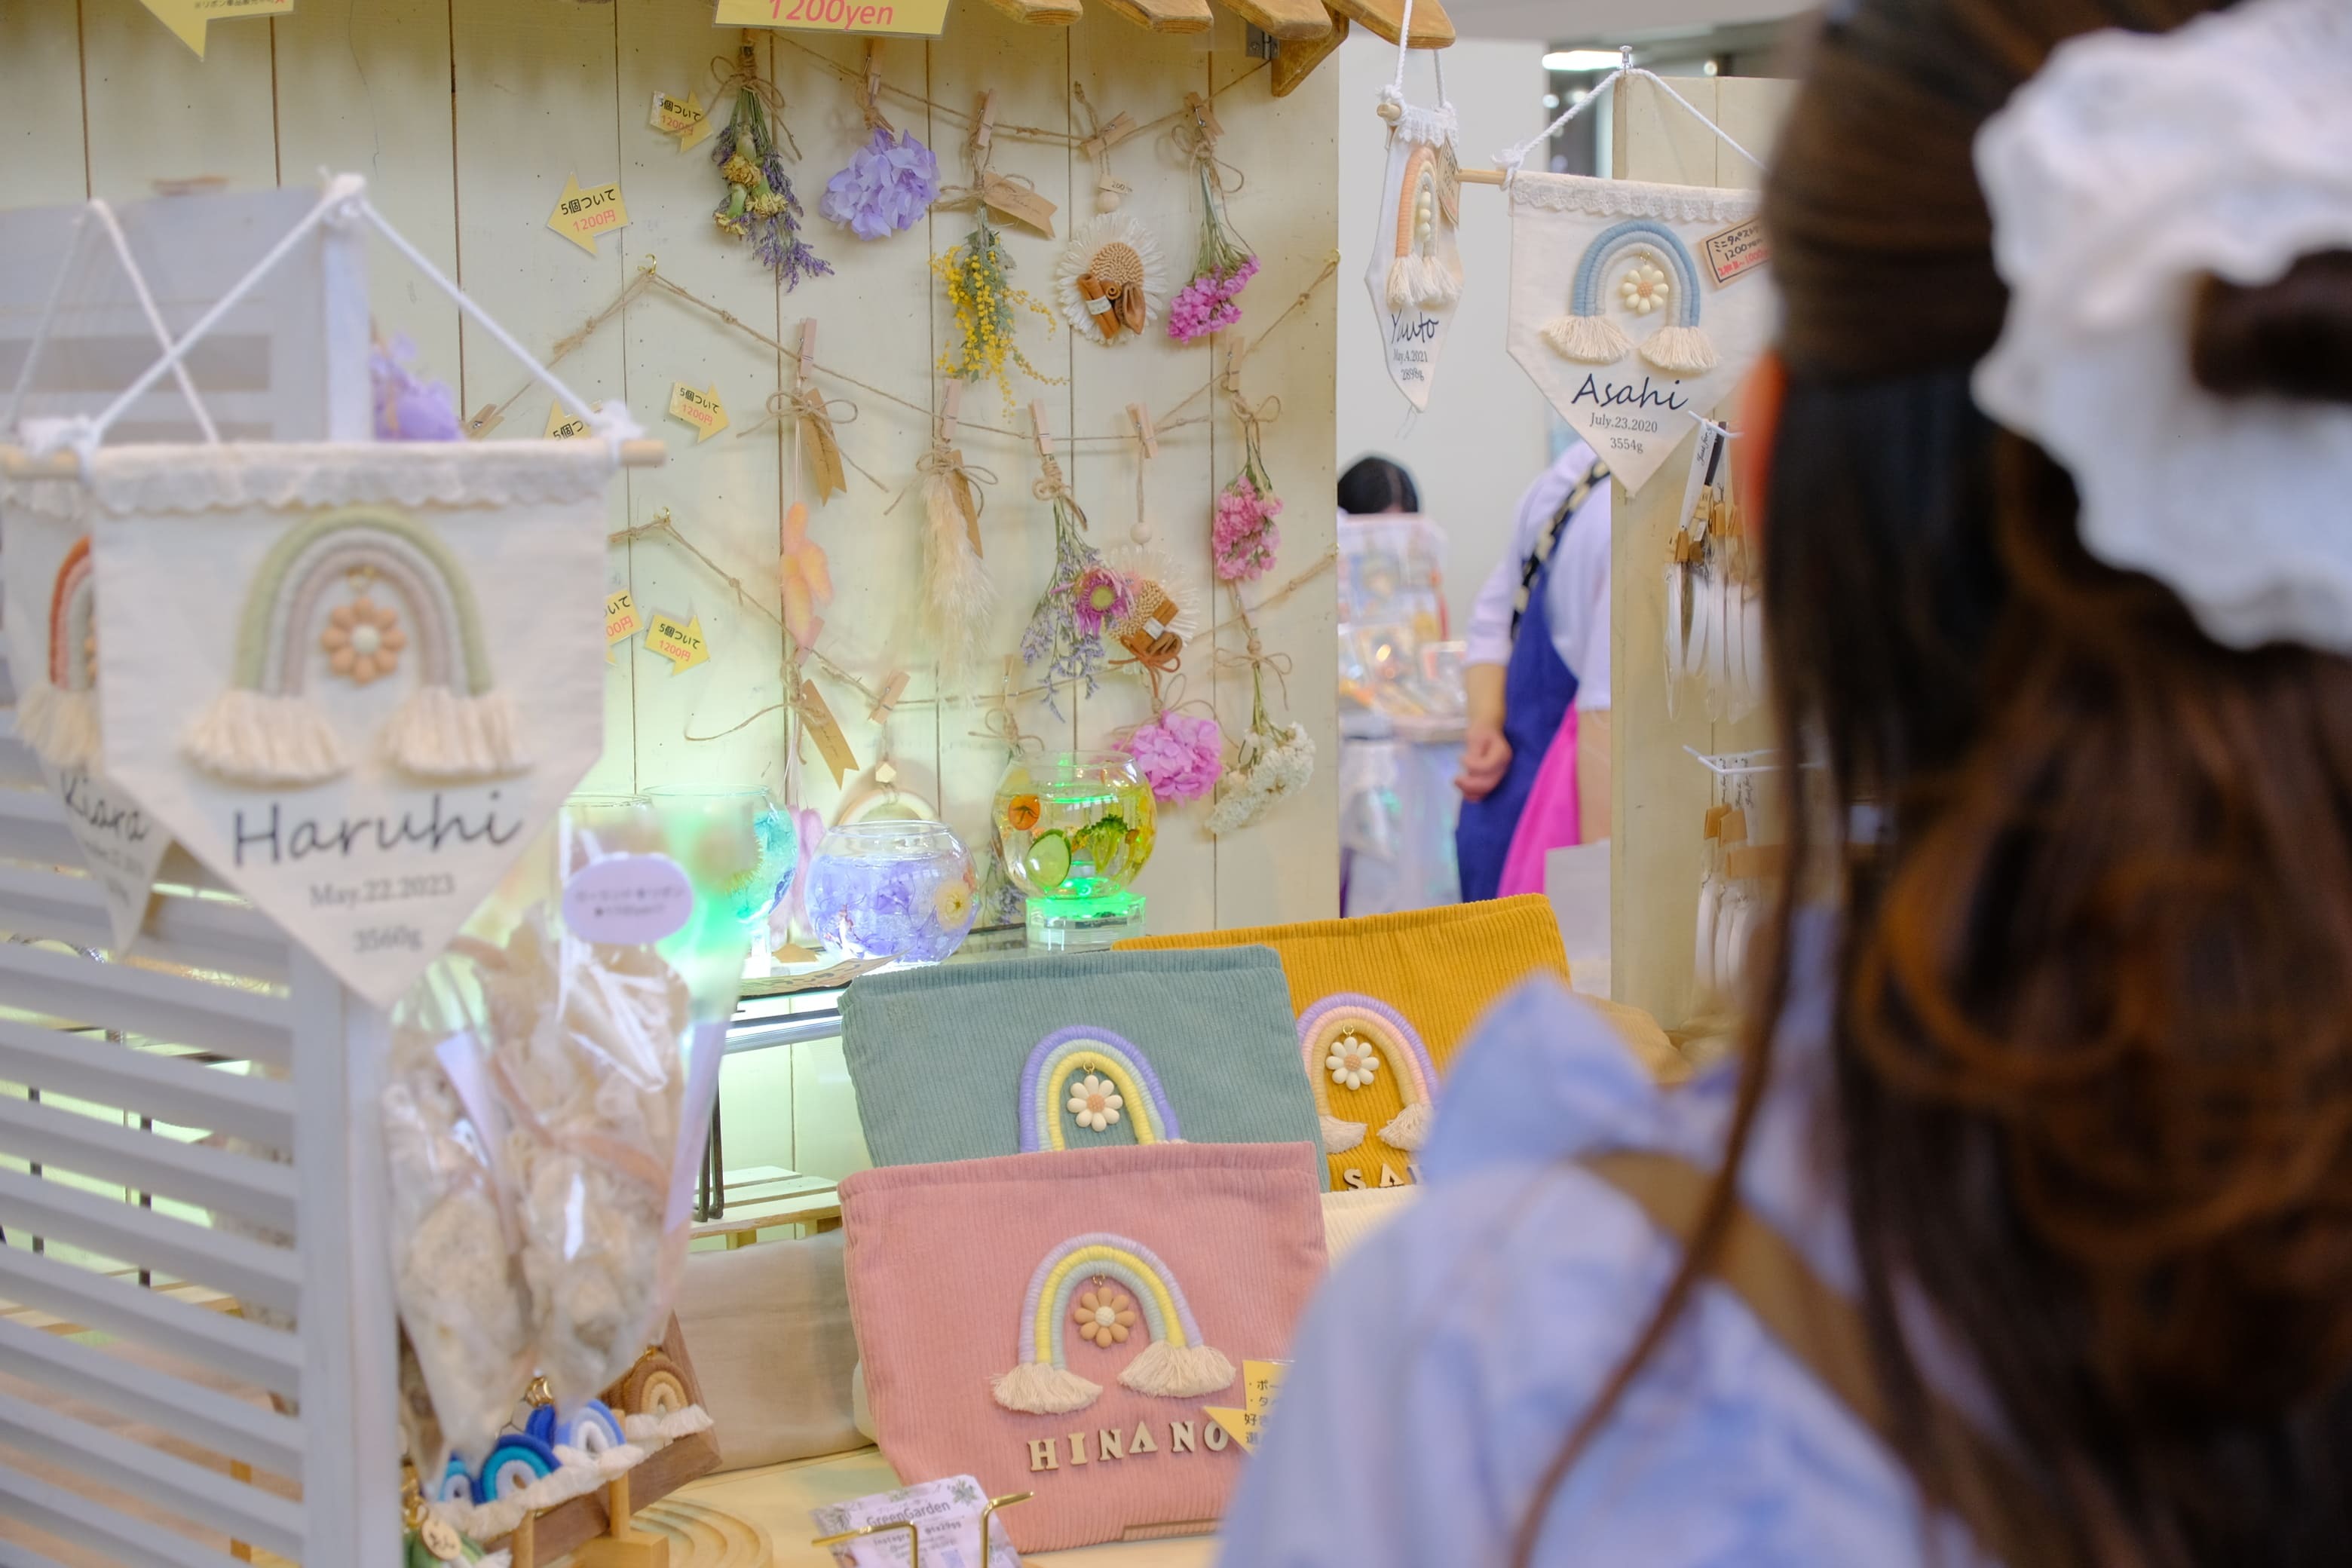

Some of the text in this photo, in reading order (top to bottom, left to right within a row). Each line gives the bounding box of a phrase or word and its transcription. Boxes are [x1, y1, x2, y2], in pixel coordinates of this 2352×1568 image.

[768, 0, 893, 30] 1200yen
[561, 188, 616, 216] 5個ついて
[573, 210, 616, 232] 1200円
[1392, 308, 1439, 344] Yuto
[679, 387, 719, 415] 5個ついて
[1571, 373, 1689, 410] Asahi
[683, 404, 712, 426] 1200円
[1589, 412, 1658, 433] July.23.2020
[1610, 437, 1643, 454] 3554g
[659, 623, 700, 650] 5個ついて
[660, 640, 691, 662] 1200円
[233, 791, 523, 868] Haruhi
[1027, 1421, 1229, 1472] HINANO
[867, 1501, 951, 1527] GreenGarden
